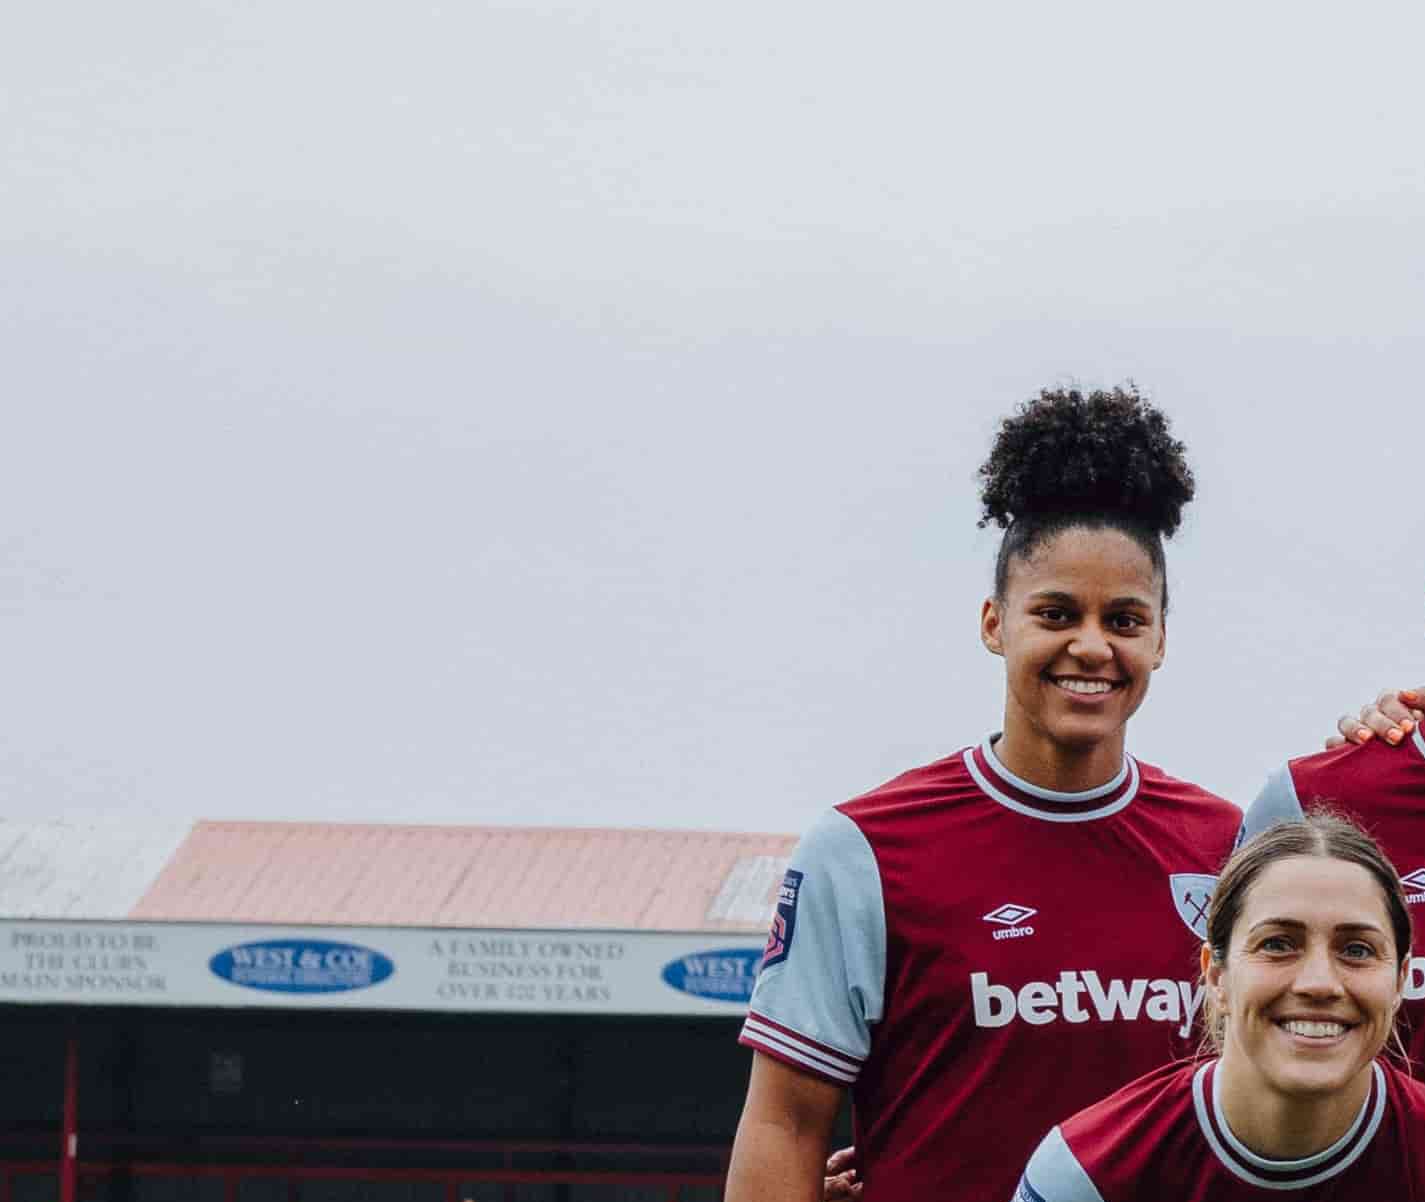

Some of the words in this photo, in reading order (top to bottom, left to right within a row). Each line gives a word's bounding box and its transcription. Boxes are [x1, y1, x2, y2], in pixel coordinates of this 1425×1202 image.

[992, 926, 1035, 941] umbro
[232, 949, 292, 969] WEST
[971, 970, 1206, 1038] betway
